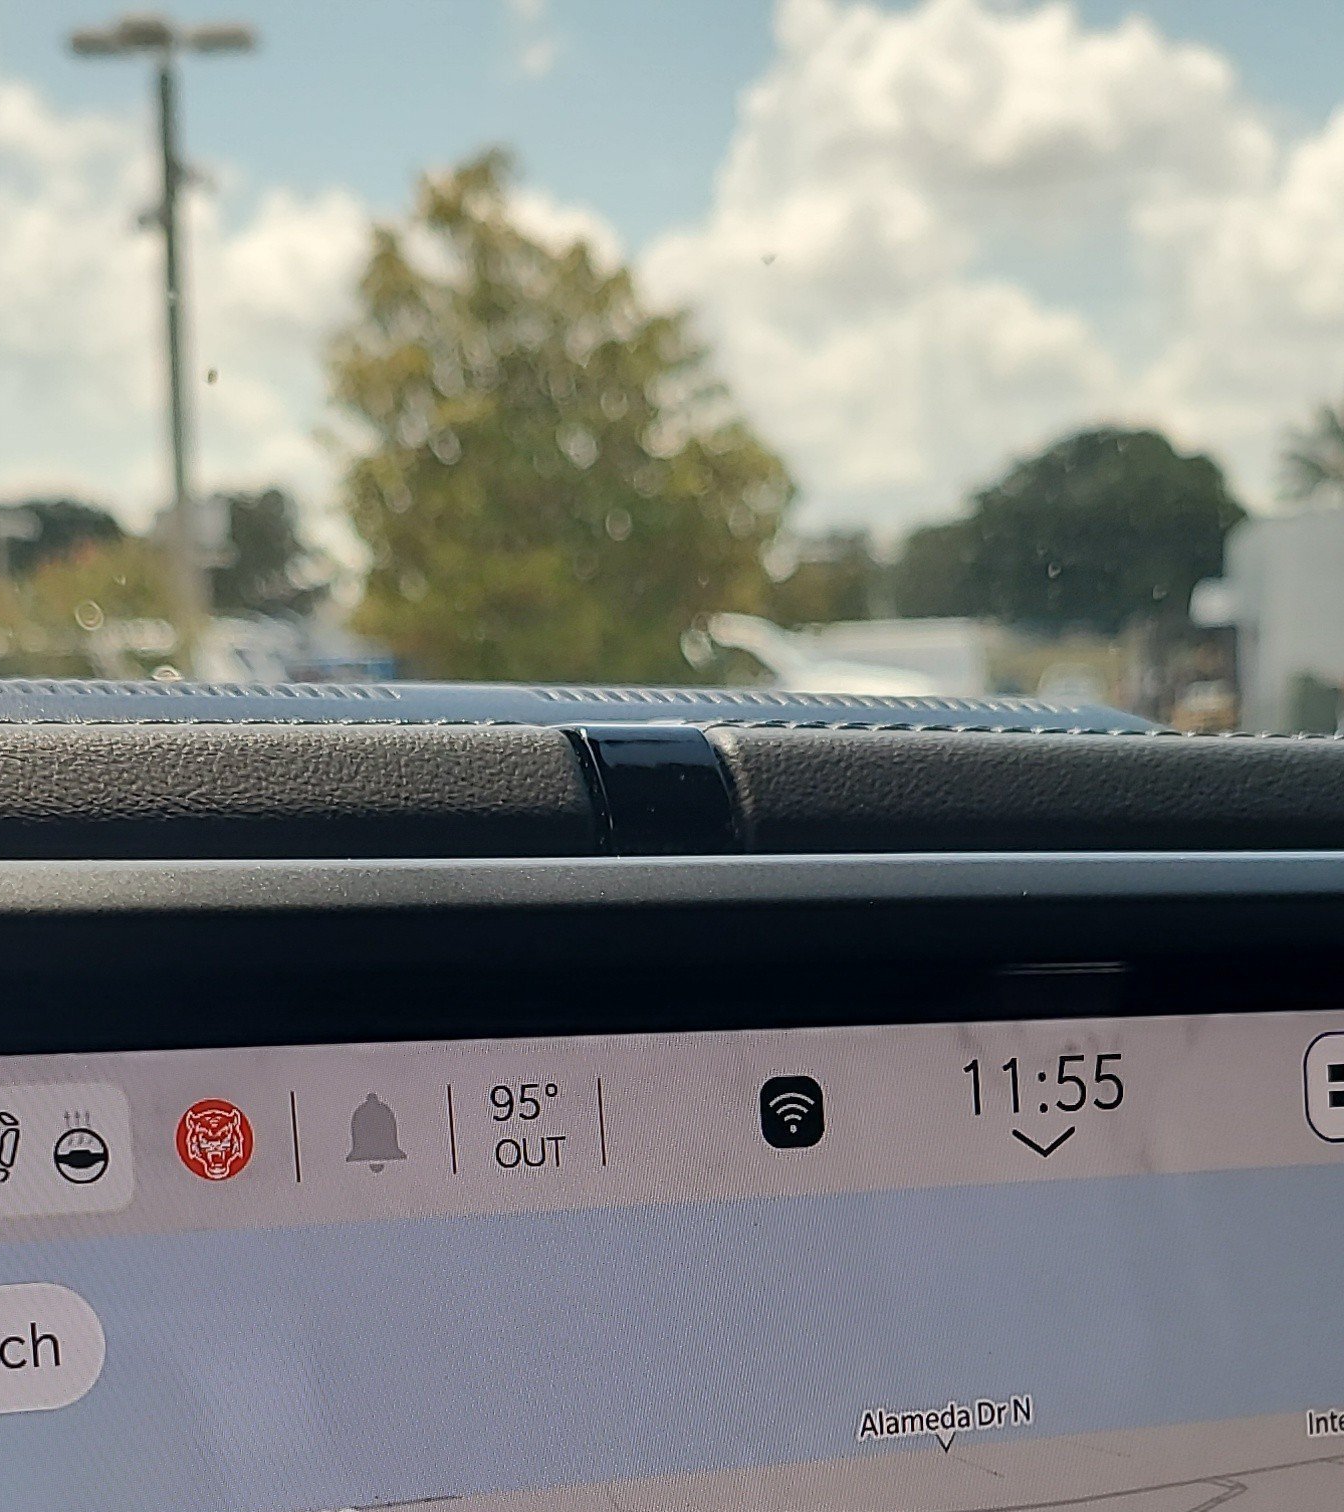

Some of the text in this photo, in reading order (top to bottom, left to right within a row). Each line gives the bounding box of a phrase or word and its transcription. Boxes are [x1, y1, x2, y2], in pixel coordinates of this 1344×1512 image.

[489, 1082, 559, 1122] 95°
[960, 1053, 1125, 1116] 11:55
[495, 1136, 567, 1170] OUT
[860, 1397, 1031, 1438] Alameda Dr N
